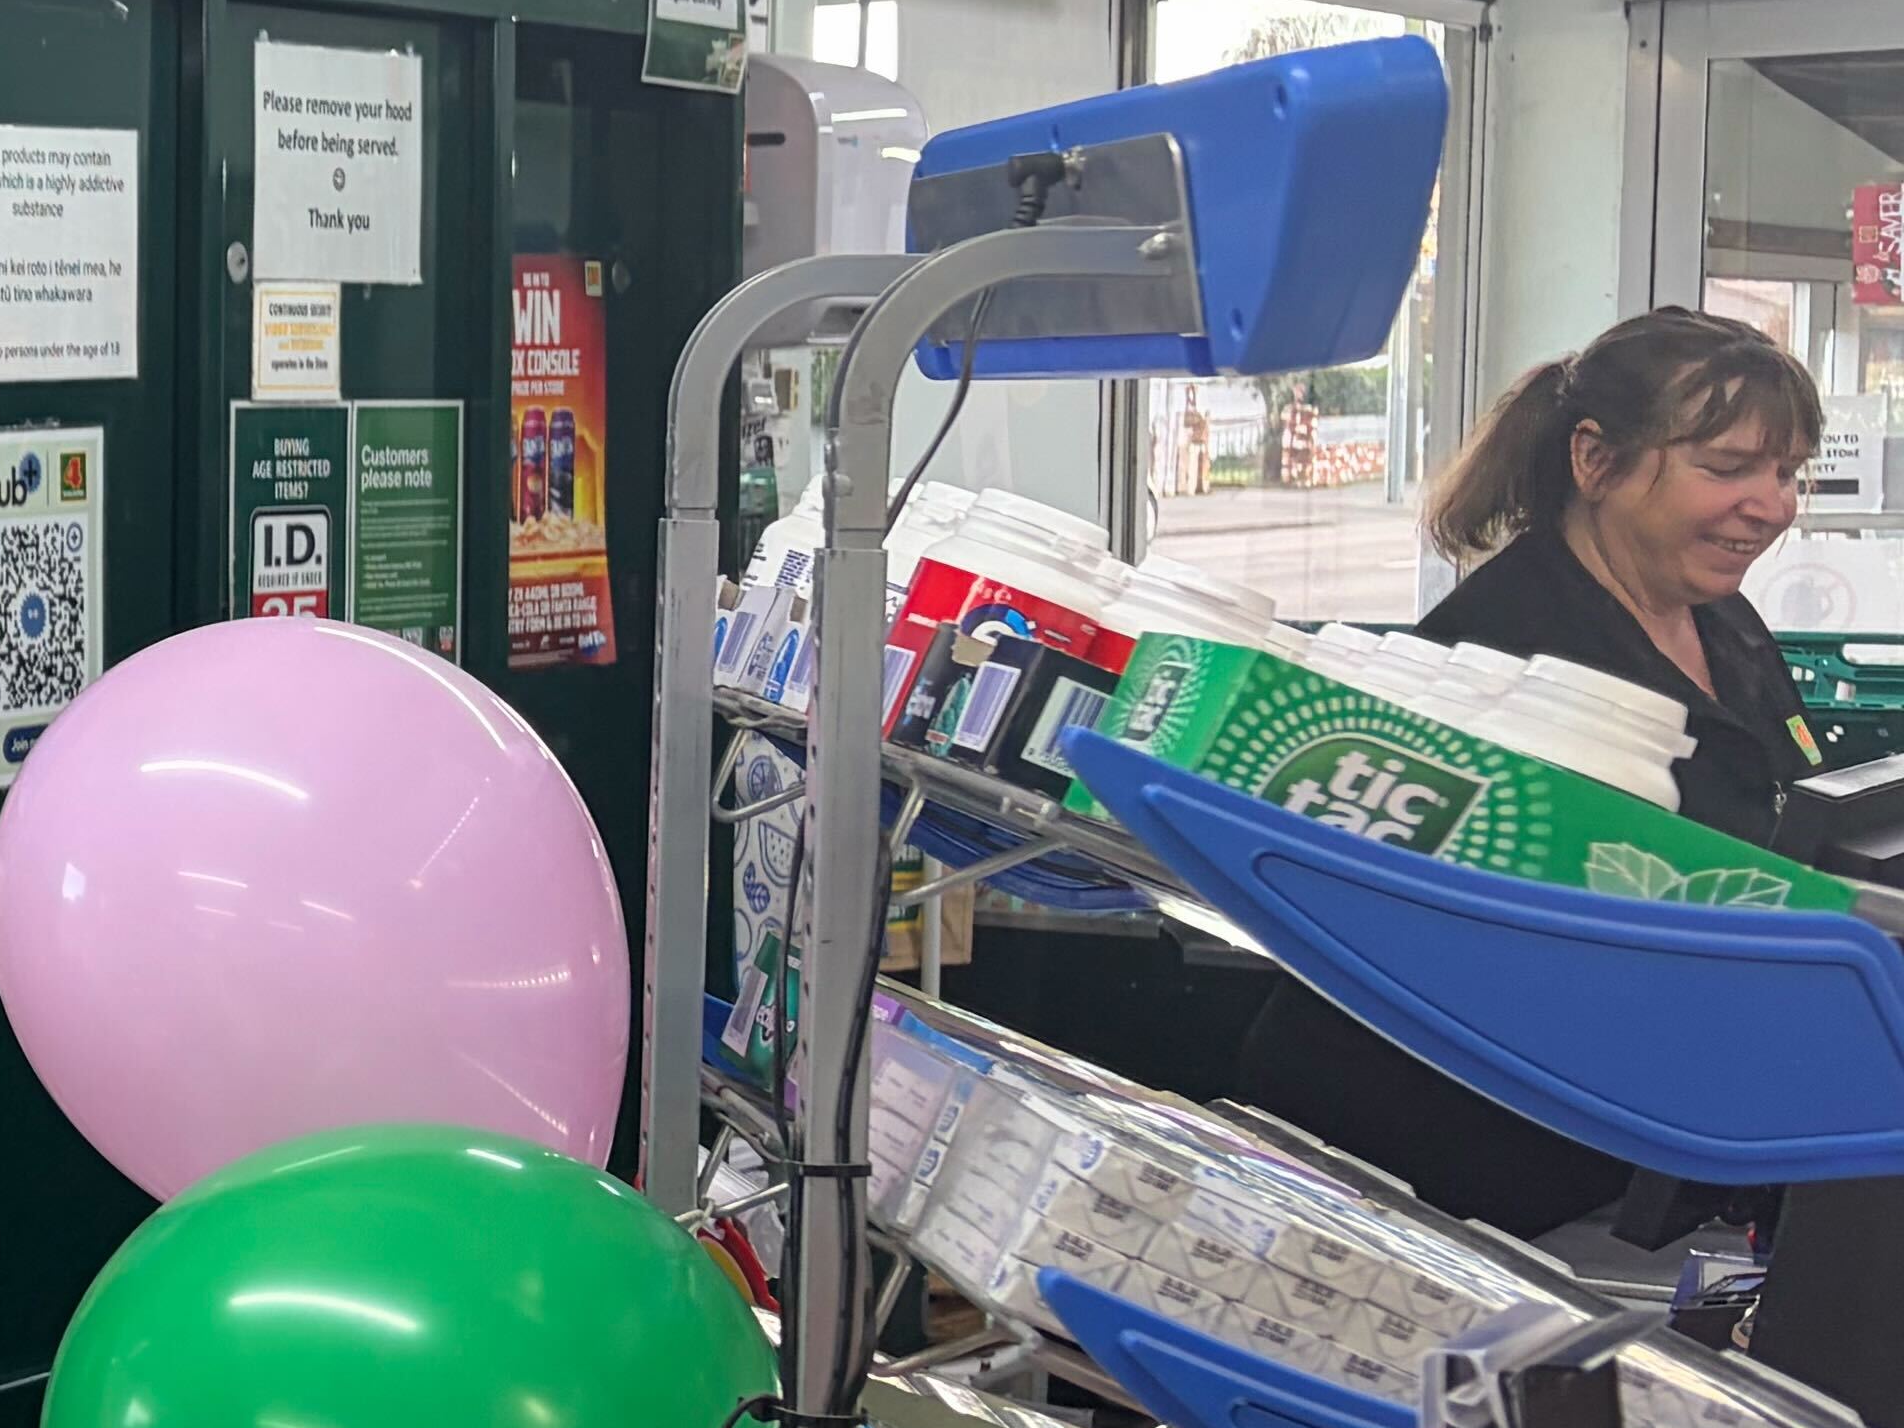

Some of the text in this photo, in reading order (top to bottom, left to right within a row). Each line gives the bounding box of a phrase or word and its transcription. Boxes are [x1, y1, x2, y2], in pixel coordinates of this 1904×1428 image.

[263, 90, 412, 121] Please remove your hood
[278, 128, 399, 158] before being served.
[2, 146, 45, 165] products
[48, 151, 70, 168] may
[73, 148, 111, 166] contain
[26, 177, 33, 190] is
[37, 179, 43, 190] a
[45, 175, 76, 195] highly
[79, 177, 124, 192] addictive
[12, 201, 63, 217] substance
[308, 207, 370, 234] Thank you
[512, 289, 561, 346] WIN
[5, 345, 38, 360] persons
[40, 343, 64, 358] under
[66, 342, 80, 357] the
[83, 344, 98, 360] age
[100, 342, 108, 356] of
[527, 349, 580, 377] CONSOLE
[274, 438, 309, 457] BUYING
[361, 444, 429, 467] Customers
[253, 459, 330, 479] AGE RESTRICTED
[361, 468, 433, 492] please note
[275, 481, 308, 501] ITEMS?
[264, 523, 322, 568] I.D.
[1337, 748, 1440, 825] tic
